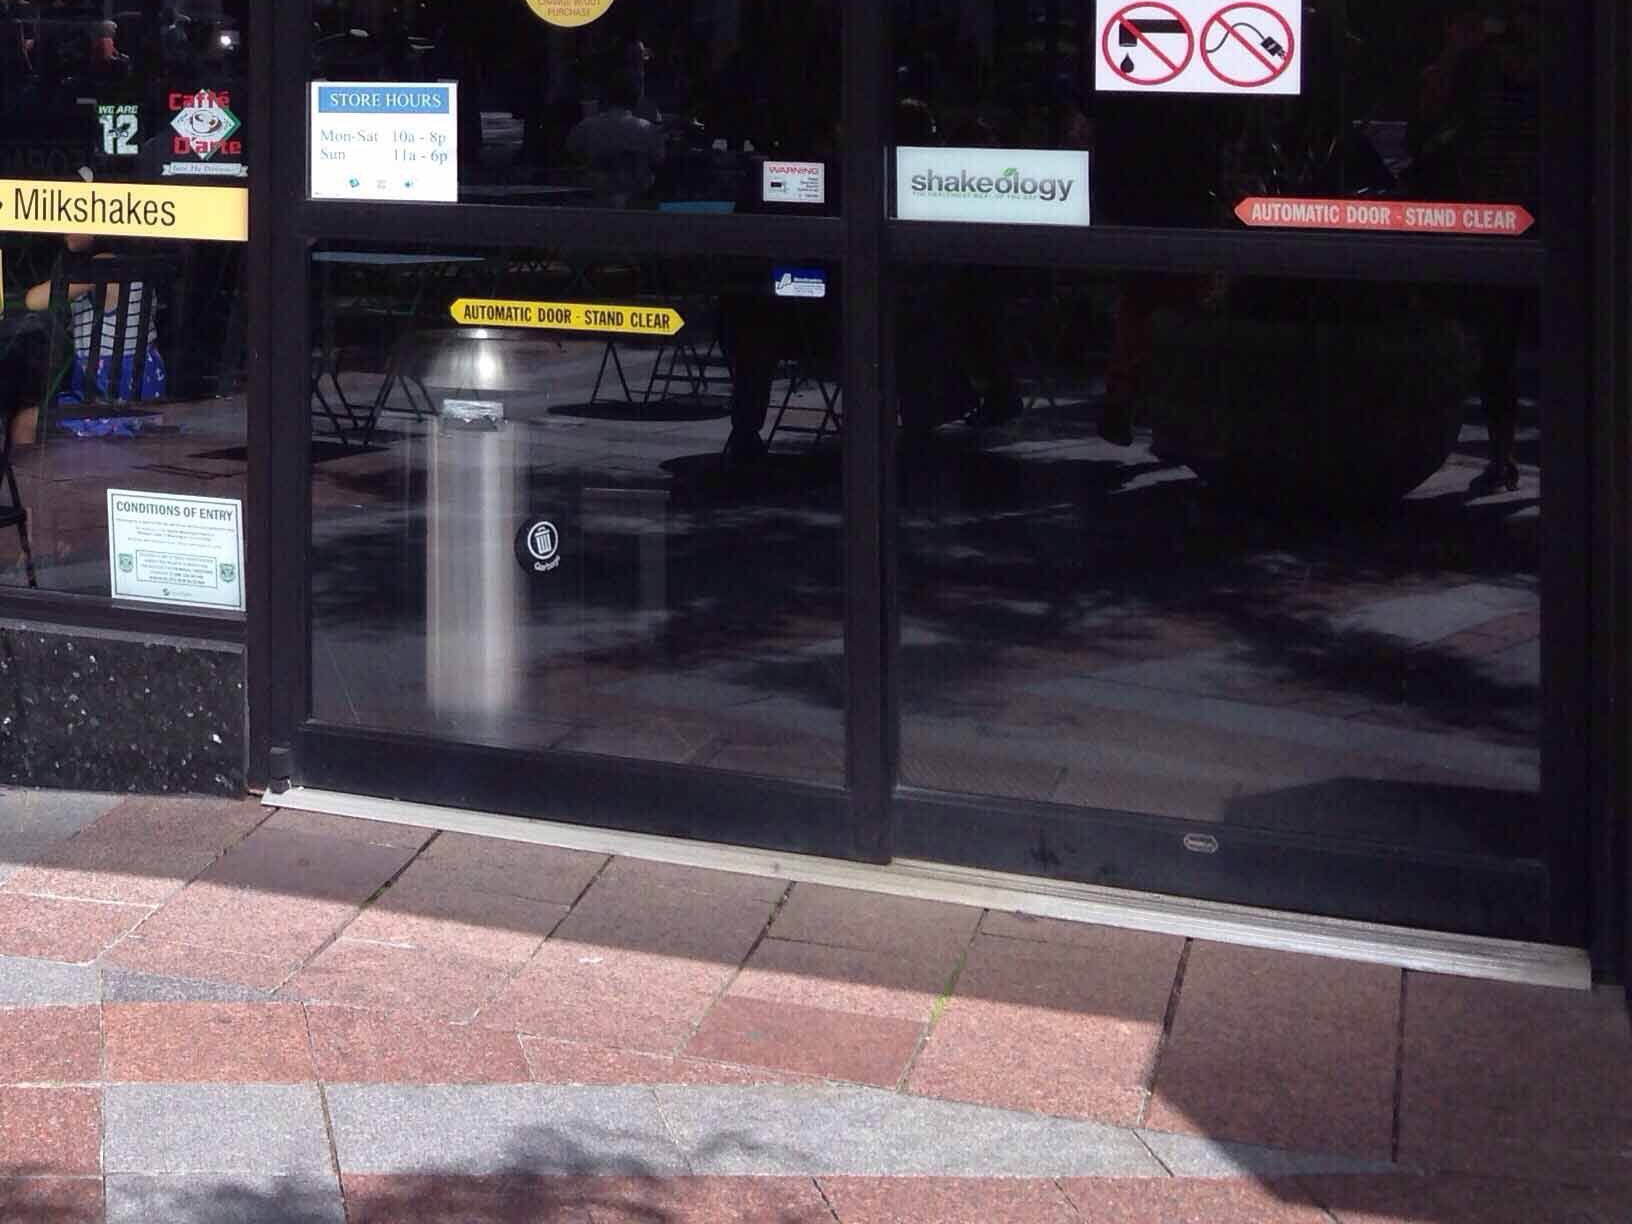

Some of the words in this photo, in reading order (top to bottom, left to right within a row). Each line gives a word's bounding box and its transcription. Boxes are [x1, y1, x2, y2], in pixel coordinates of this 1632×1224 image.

[547, 7, 590, 17] PURCHASE
[98, 105, 114, 114] WE
[116, 105, 139, 114] ARE
[329, 92, 381, 107] STORE
[385, 93, 441, 108] HOURS
[99, 114, 139, 154] 12
[319, 129, 379, 143] Mon-Sat
[393, 129, 415, 143] 10a
[429, 131, 446, 147] 8p
[319, 149, 346, 161] Sun
[394, 149, 416, 161] 11a
[430, 150, 448, 165] 6p
[768, 166, 818, 175] WARNING
[911, 168, 1074, 202] shakeology
[13, 188, 177, 228] Milkshakes
[1250, 203, 1340, 224] AUTOMATIC
[1346, 205, 1391, 225] DOOR
[1405, 207, 1456, 228] STAND
[1462, 209, 1518, 230] CLEAR
[463, 303, 532, 323] AUTOMATIC
[537, 305, 572, 324] DOOR
[584, 309, 625, 327] STAND
[630, 312, 670, 330] CLEAR
[116, 500, 181, 517] CONDITIONS
[183, 506, 197, 517] OF
[199, 508, 233, 521] ENTRY
